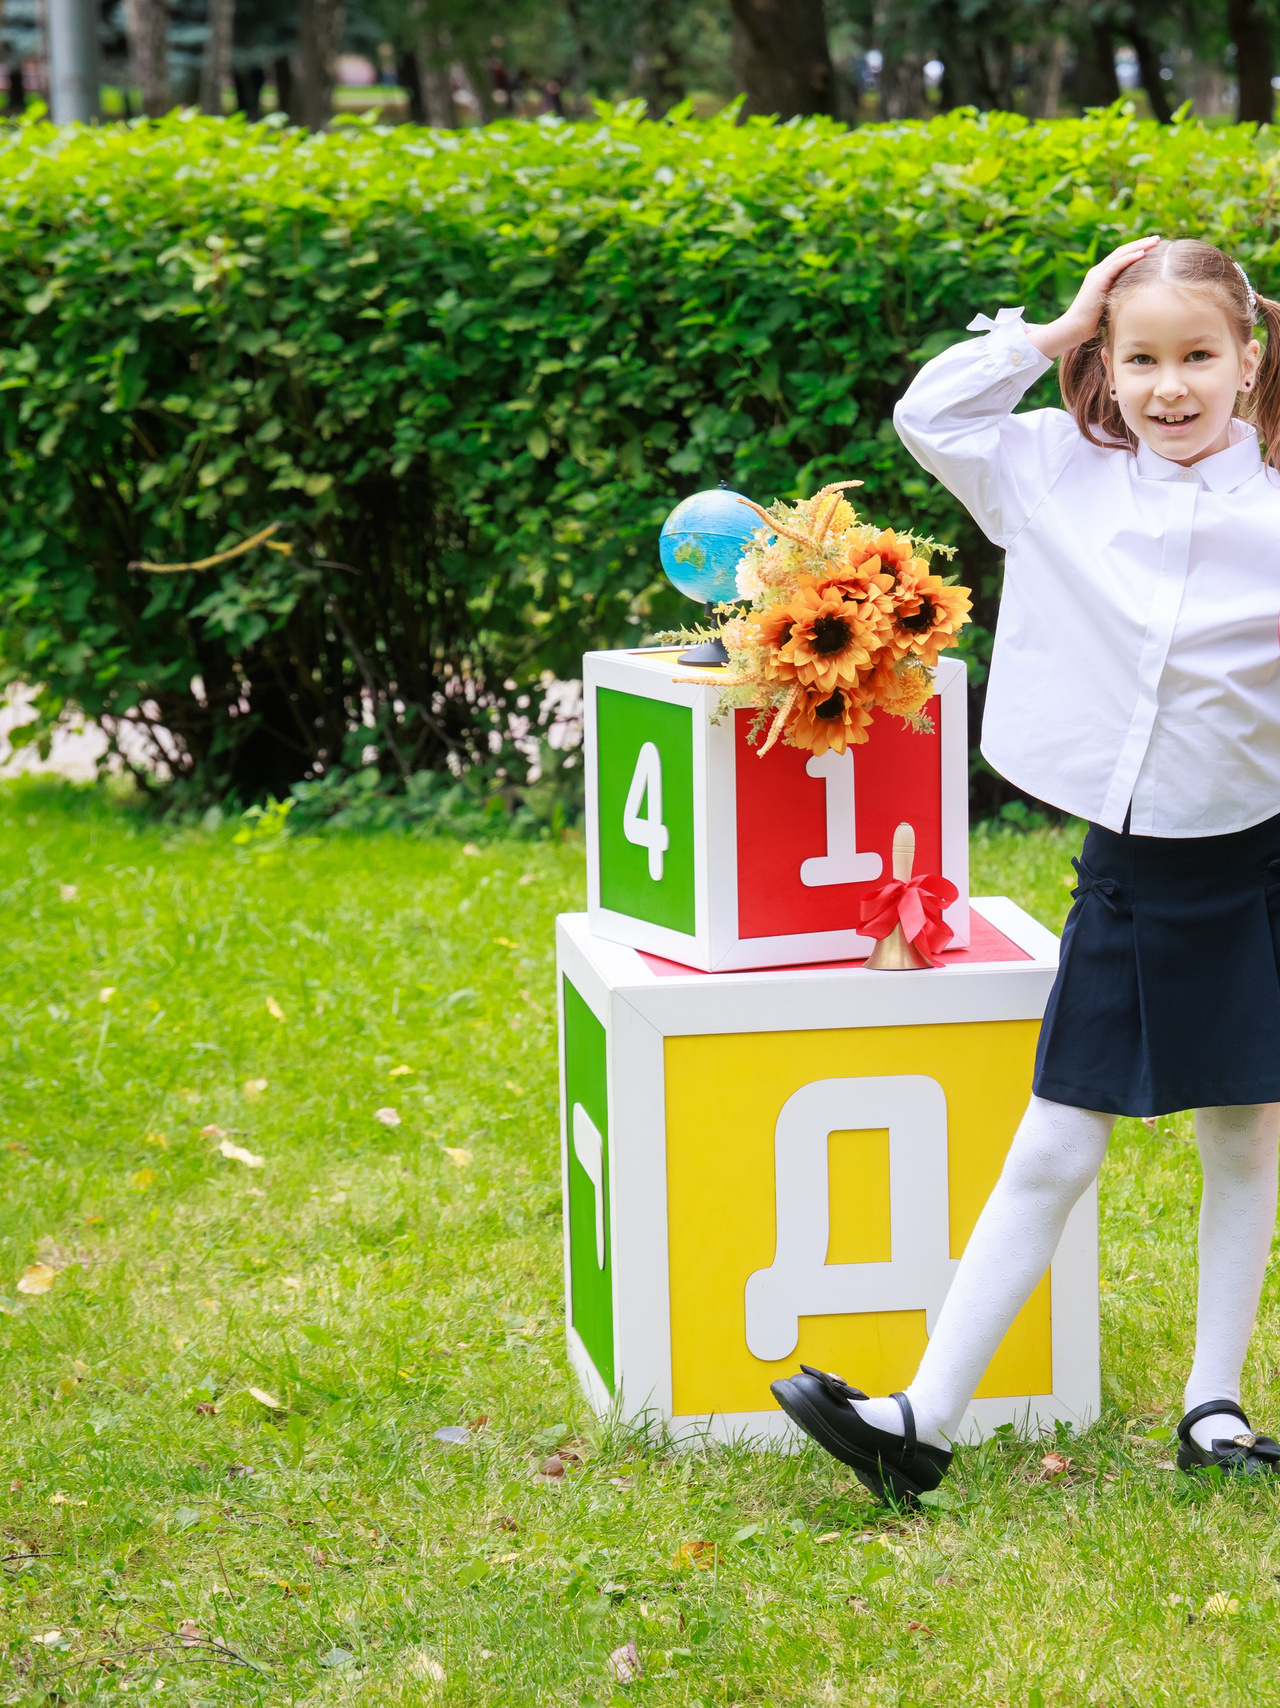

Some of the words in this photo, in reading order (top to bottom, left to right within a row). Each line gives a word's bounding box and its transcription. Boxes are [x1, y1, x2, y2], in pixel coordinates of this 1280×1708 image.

[623, 741, 670, 882] 4
[800, 746, 883, 887] 1
[744, 1075, 960, 1362] Д
